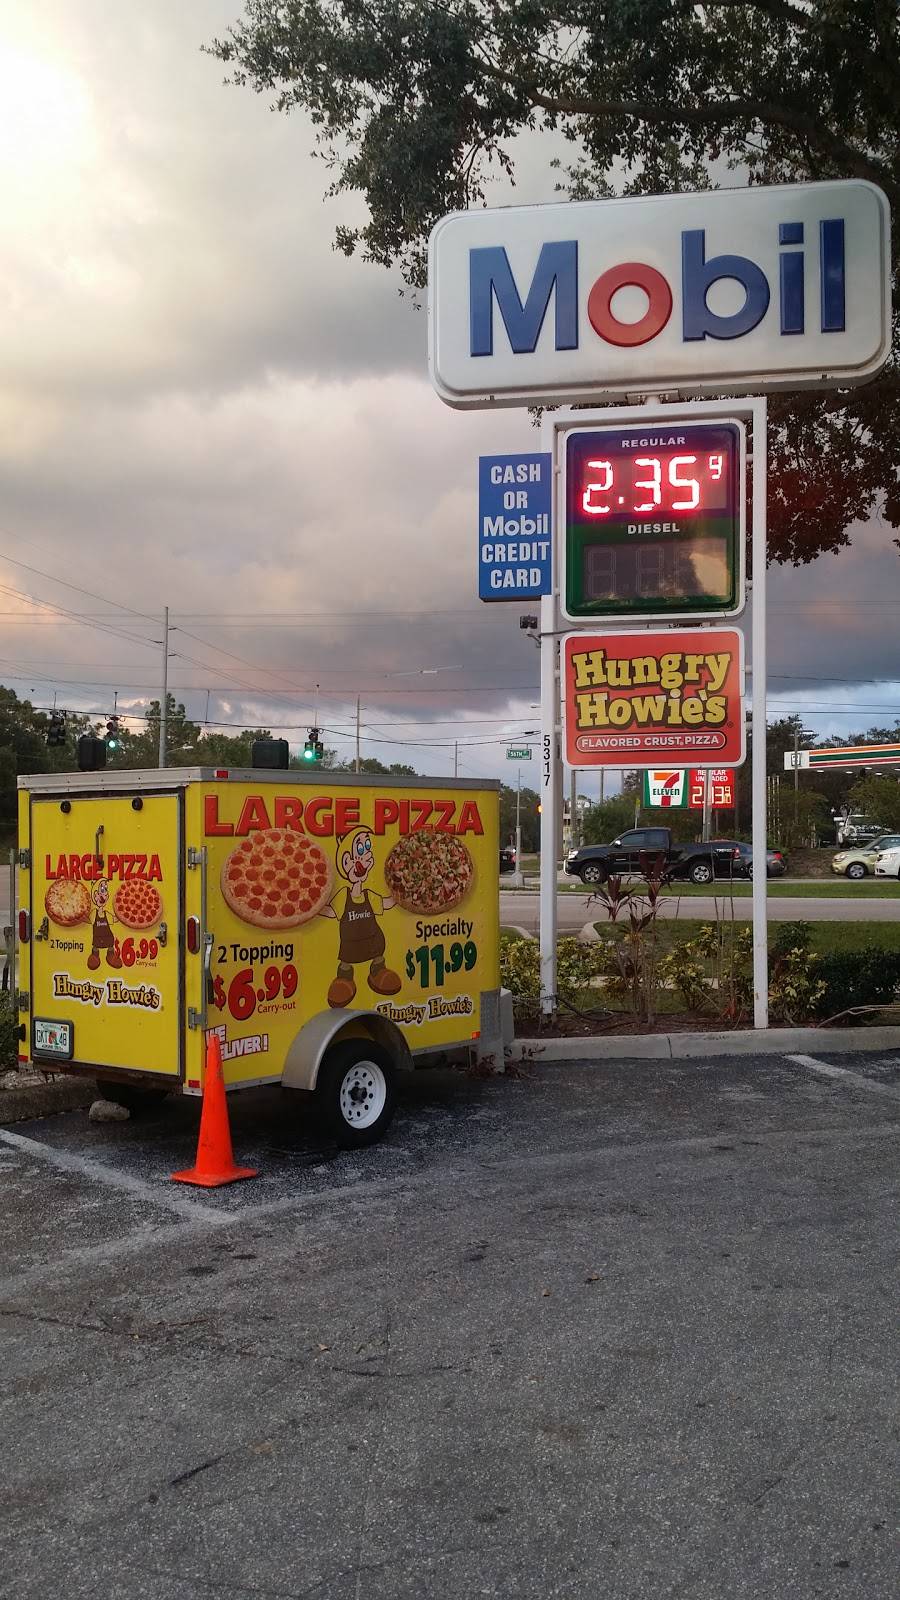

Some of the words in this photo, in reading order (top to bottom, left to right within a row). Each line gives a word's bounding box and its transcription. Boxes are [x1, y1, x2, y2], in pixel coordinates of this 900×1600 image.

[469, 218, 845, 357] Mobil
[621, 436, 686, 448] REGULAR
[490, 464, 541, 485] CASH
[503, 490, 528, 510] OR
[483, 513, 549, 537] Mobil
[627, 523, 680, 535] DIESEL
[481, 541, 550, 564] CREDIT
[490, 568, 542, 589] CARD
[571, 649, 731, 692] Hungry
[575, 688, 727, 728] Howie's
[581, 737, 641, 748] FLAVORED
[684, 735, 720, 745] PIZZA
[204, 795, 361, 837] LARGE
[374, 798, 484, 836] PIZZA
[45, 853, 104, 881] LARGE
[107, 853, 163, 882] PIZZA
[348, 909, 371, 921] Howie
[415, 917, 474, 942] Specialty
[50, 939, 55, 949] 2
[56, 940, 84, 953] Topping
[114, 937, 159, 968] $6.99
[217, 945, 228, 964] 2
[230, 939, 294, 966] Topping
[405, 940, 477, 988] $11.99
[53, 974, 104, 1006] Hungry
[107, 980, 160, 1009] Howie's
[213, 963, 299, 1021] $6.99
[257, 1000, 296, 1015] Carry-out
[377, 1002, 426, 1024] Hungry
[427, 996, 473, 1019] Howie's
